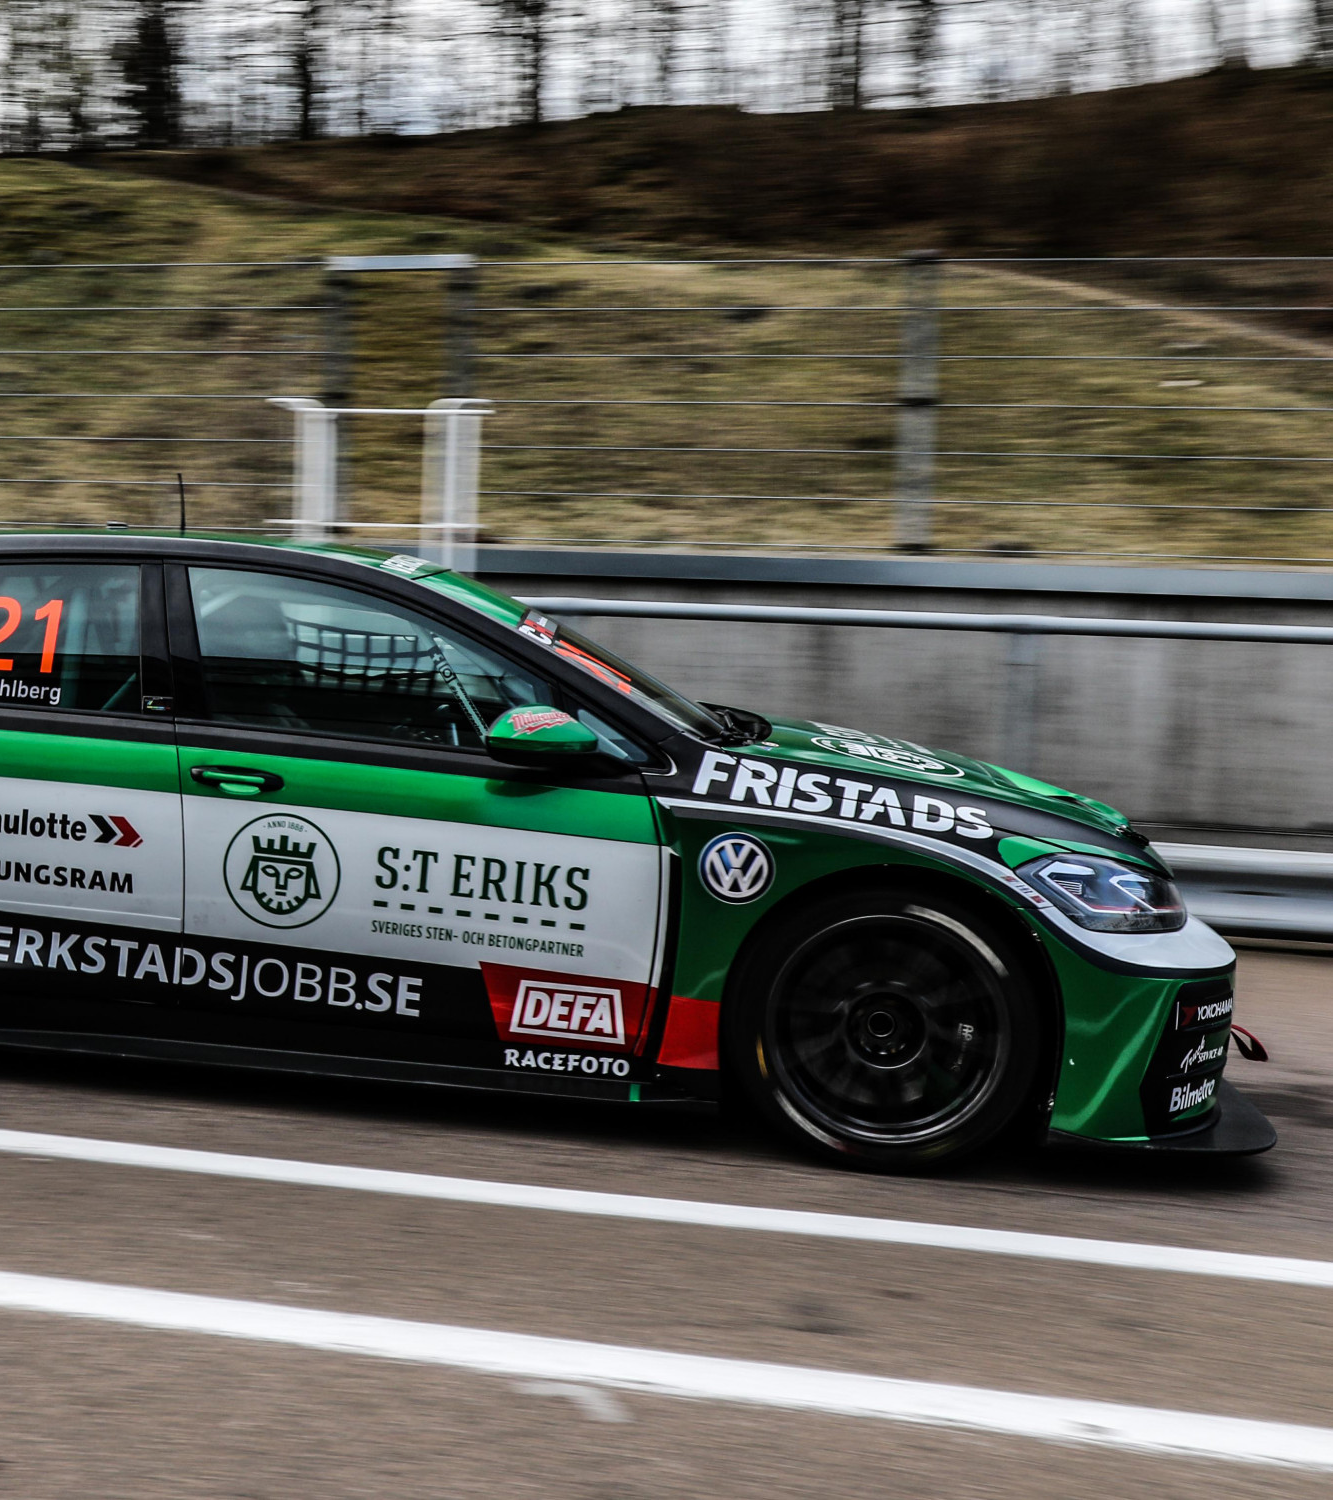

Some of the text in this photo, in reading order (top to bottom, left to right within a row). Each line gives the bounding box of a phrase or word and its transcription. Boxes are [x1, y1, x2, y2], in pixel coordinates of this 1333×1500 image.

[691, 750, 995, 839] FRISTADS
[375, 846, 590, 911] S:T ERIKS
[371, 920, 584, 957] SVERIGES STEN- OCH BETONGPARTNER
[522, 990, 614, 1034] DEFA
[504, 1048, 630, 1077] RACEFOTO
[1169, 1078, 1216, 1112] Bilmetro
